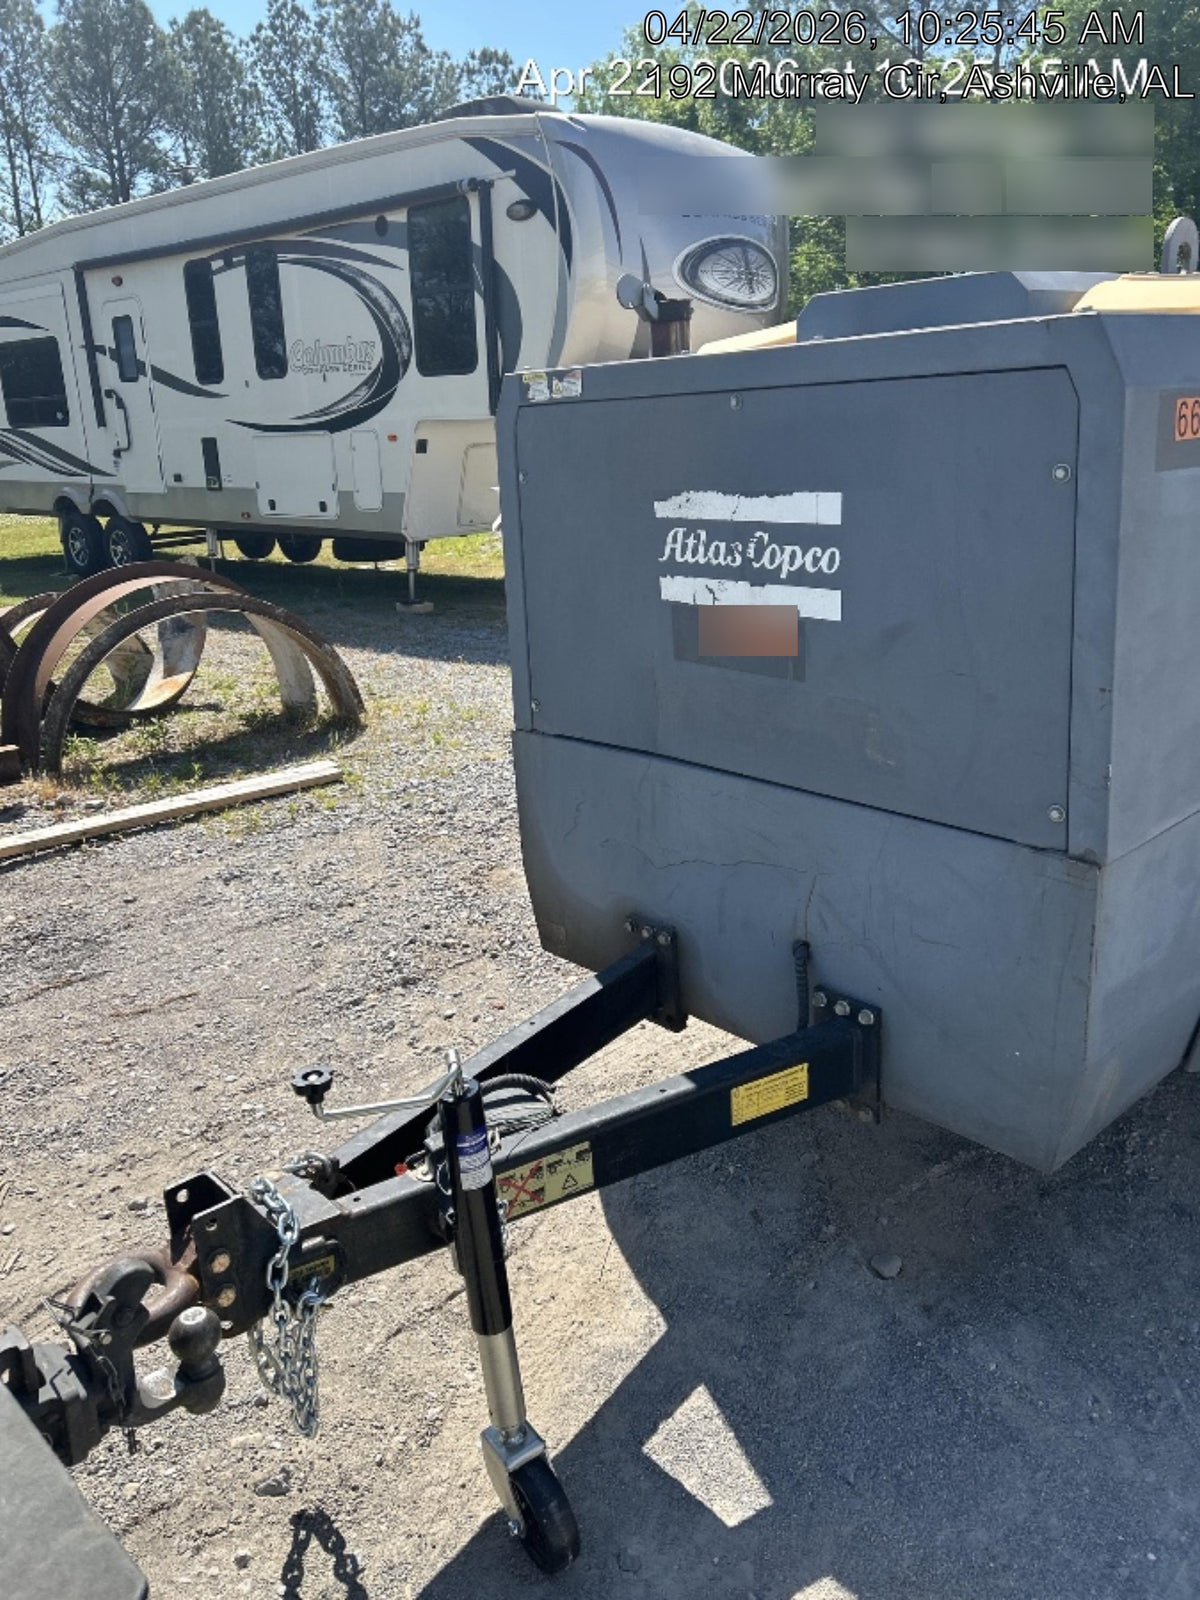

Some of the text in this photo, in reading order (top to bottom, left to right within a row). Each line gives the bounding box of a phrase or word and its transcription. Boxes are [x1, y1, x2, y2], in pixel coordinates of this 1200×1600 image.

[289, 335, 376, 373] Columbus
[658, 526, 841, 579] Atlas Copco
